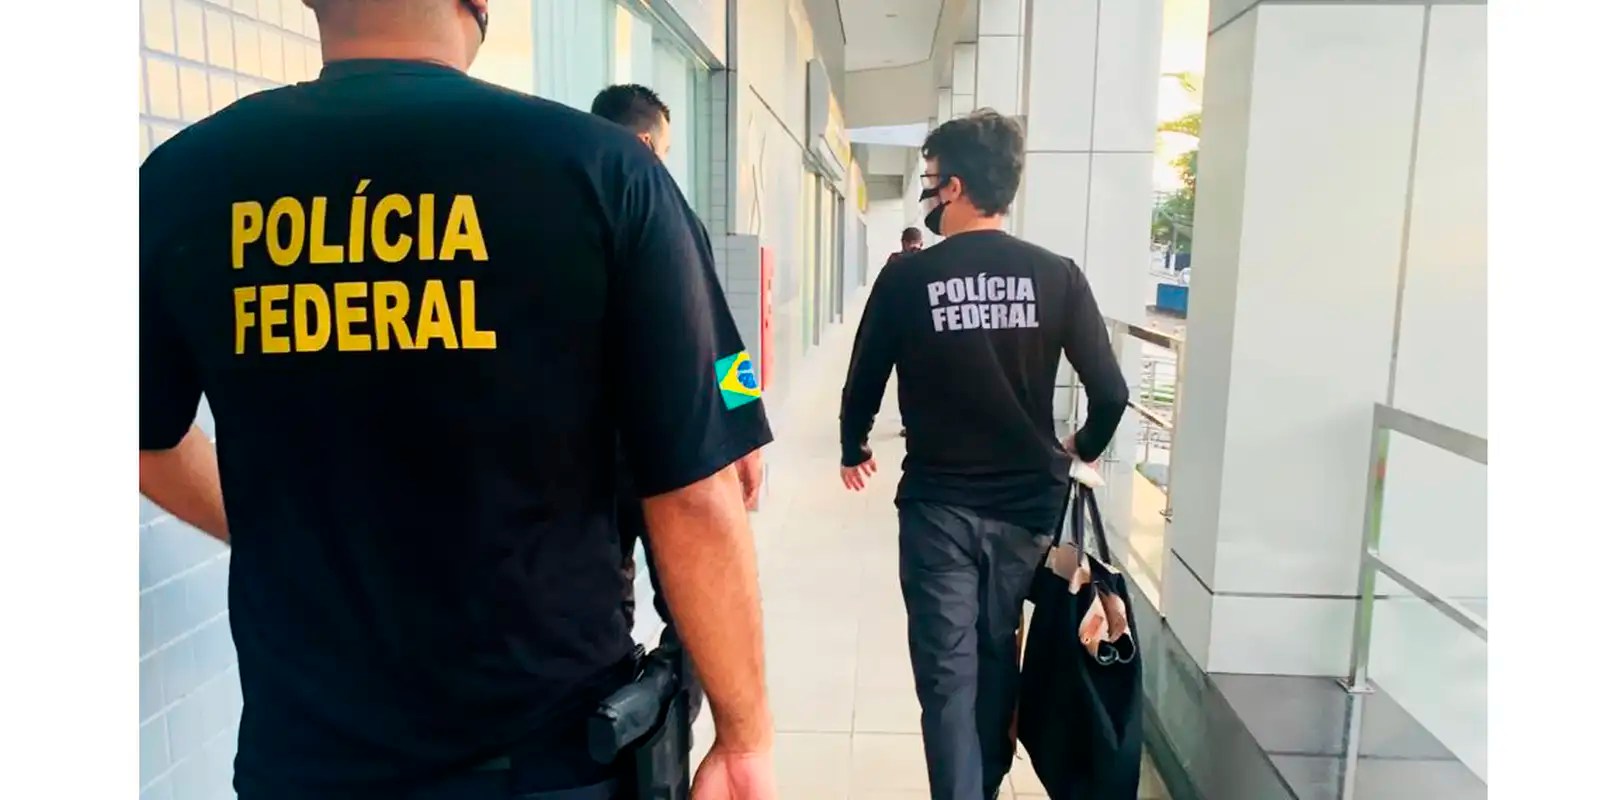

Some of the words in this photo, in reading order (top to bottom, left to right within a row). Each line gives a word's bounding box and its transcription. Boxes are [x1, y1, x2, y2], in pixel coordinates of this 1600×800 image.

[231, 180, 489, 269] POLÍCIA
[233, 279, 497, 355] FEDERAL
[927, 272, 1036, 307] POLÍCIA
[931, 303, 1040, 333] FEDERAL
